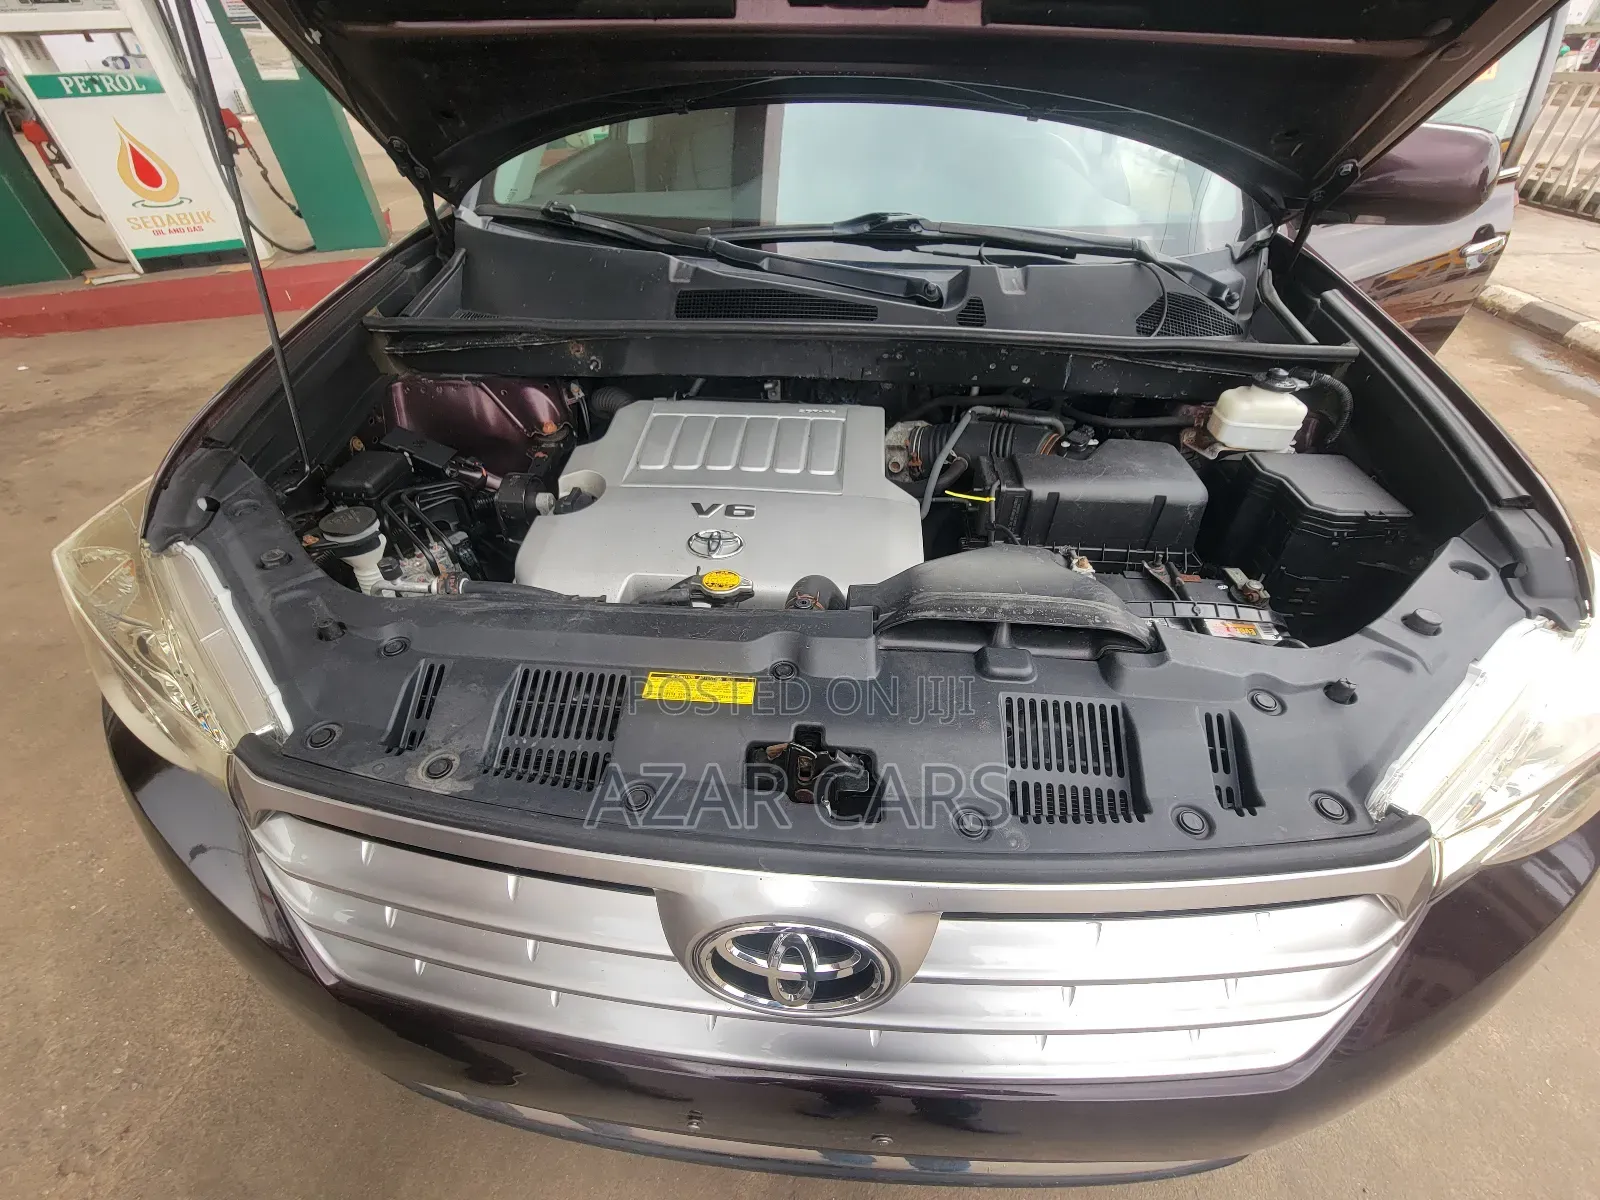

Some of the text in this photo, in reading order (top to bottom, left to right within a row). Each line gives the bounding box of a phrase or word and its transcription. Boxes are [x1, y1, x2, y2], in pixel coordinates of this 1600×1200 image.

[58, 74, 146, 95] PETROL
[126, 211, 215, 230] SEDABUK
[168, 227, 185, 235] AND
[691, 502, 757, 520] V6
